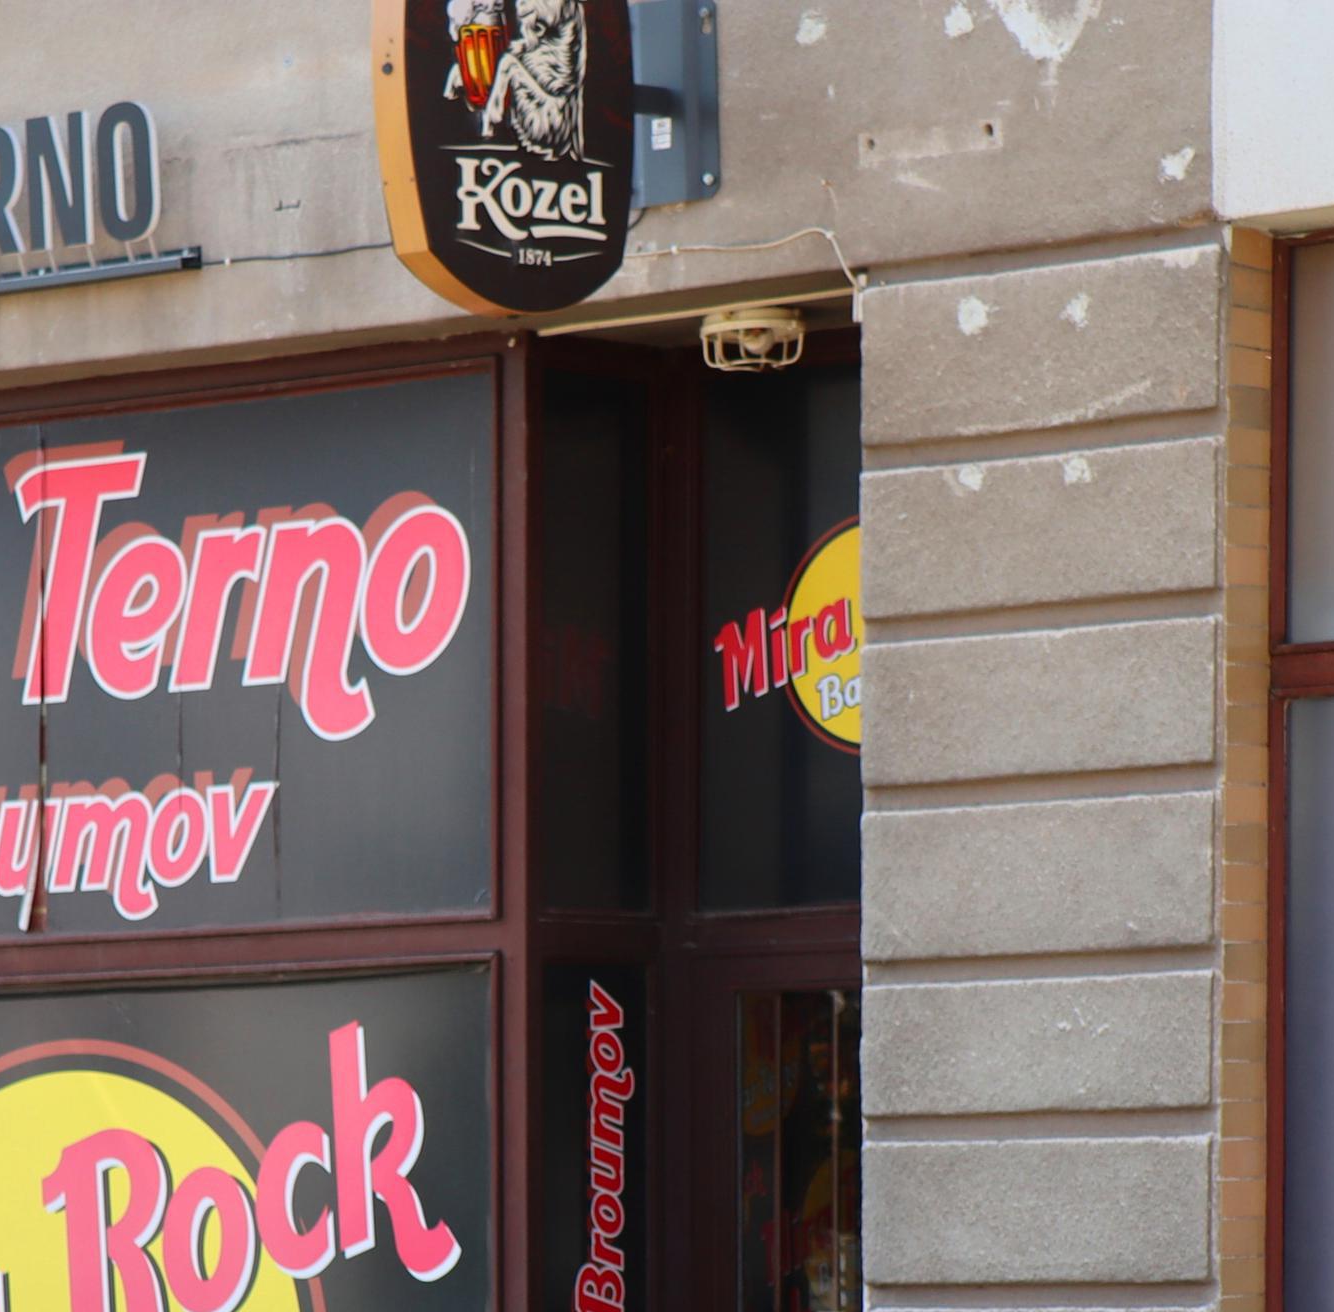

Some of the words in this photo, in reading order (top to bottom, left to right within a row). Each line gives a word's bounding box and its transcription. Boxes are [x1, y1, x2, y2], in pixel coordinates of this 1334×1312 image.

[455, 157, 608, 241] Kozel
[518, 247, 553, 267] 1874
[14, 451, 472, 742] Terno
